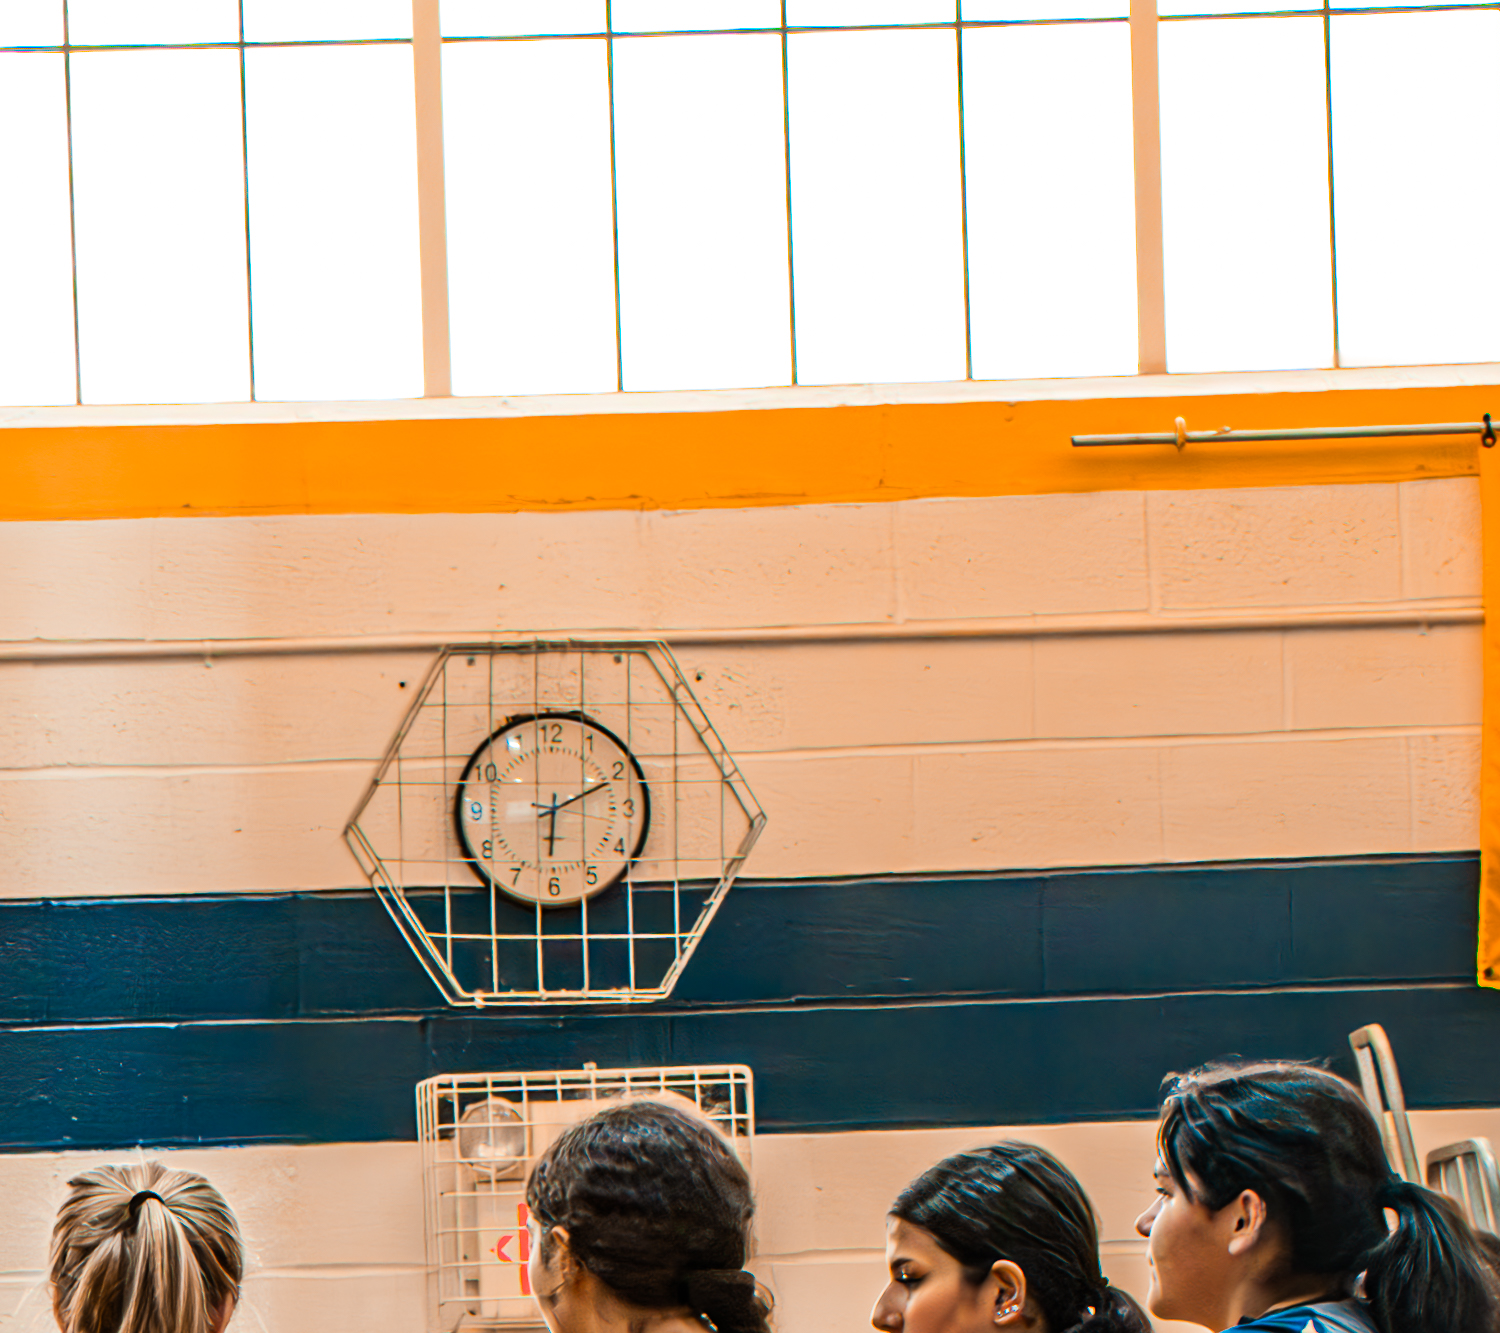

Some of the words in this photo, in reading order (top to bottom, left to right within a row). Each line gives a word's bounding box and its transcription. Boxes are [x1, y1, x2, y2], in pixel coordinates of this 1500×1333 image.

[540, 723, 563, 743] 12
[585, 734, 594, 752] 1
[475, 762, 498, 783] 10
[612, 761, 626, 781] 2
[471, 801, 483, 821] 9
[622, 798, 635, 818] 3
[482, 839, 493, 860] 8
[613, 837, 626, 855] 4
[510, 867, 522, 886] 7
[585, 866, 598, 886] 5
[549, 877, 561, 897] 6
